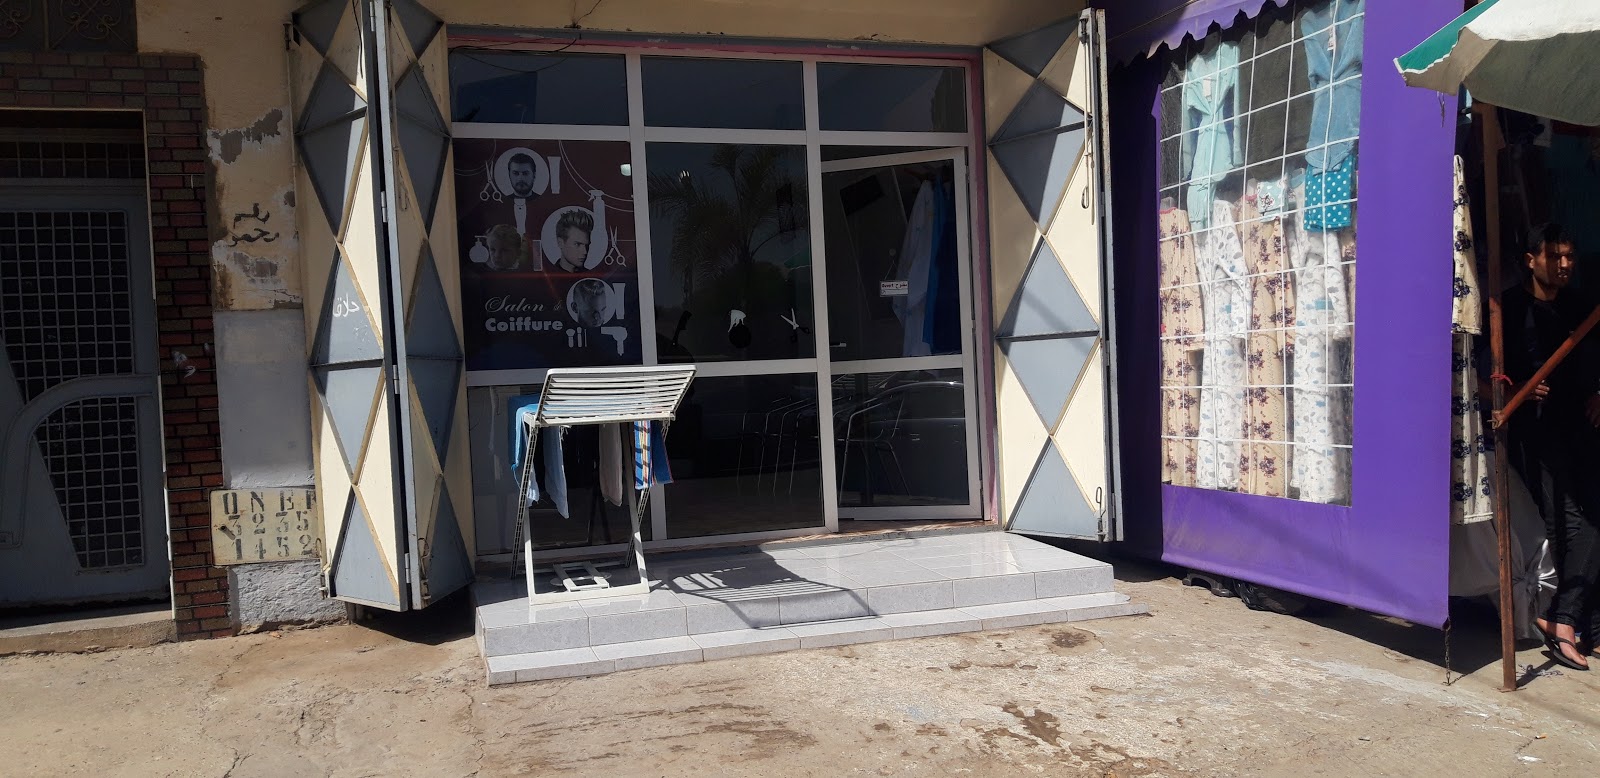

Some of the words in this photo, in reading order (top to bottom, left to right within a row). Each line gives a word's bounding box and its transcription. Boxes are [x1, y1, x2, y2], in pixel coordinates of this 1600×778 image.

[333, 293, 360, 317] حلاق
[485, 295, 544, 313] Salon
[485, 316, 563, 332] Coiffure
